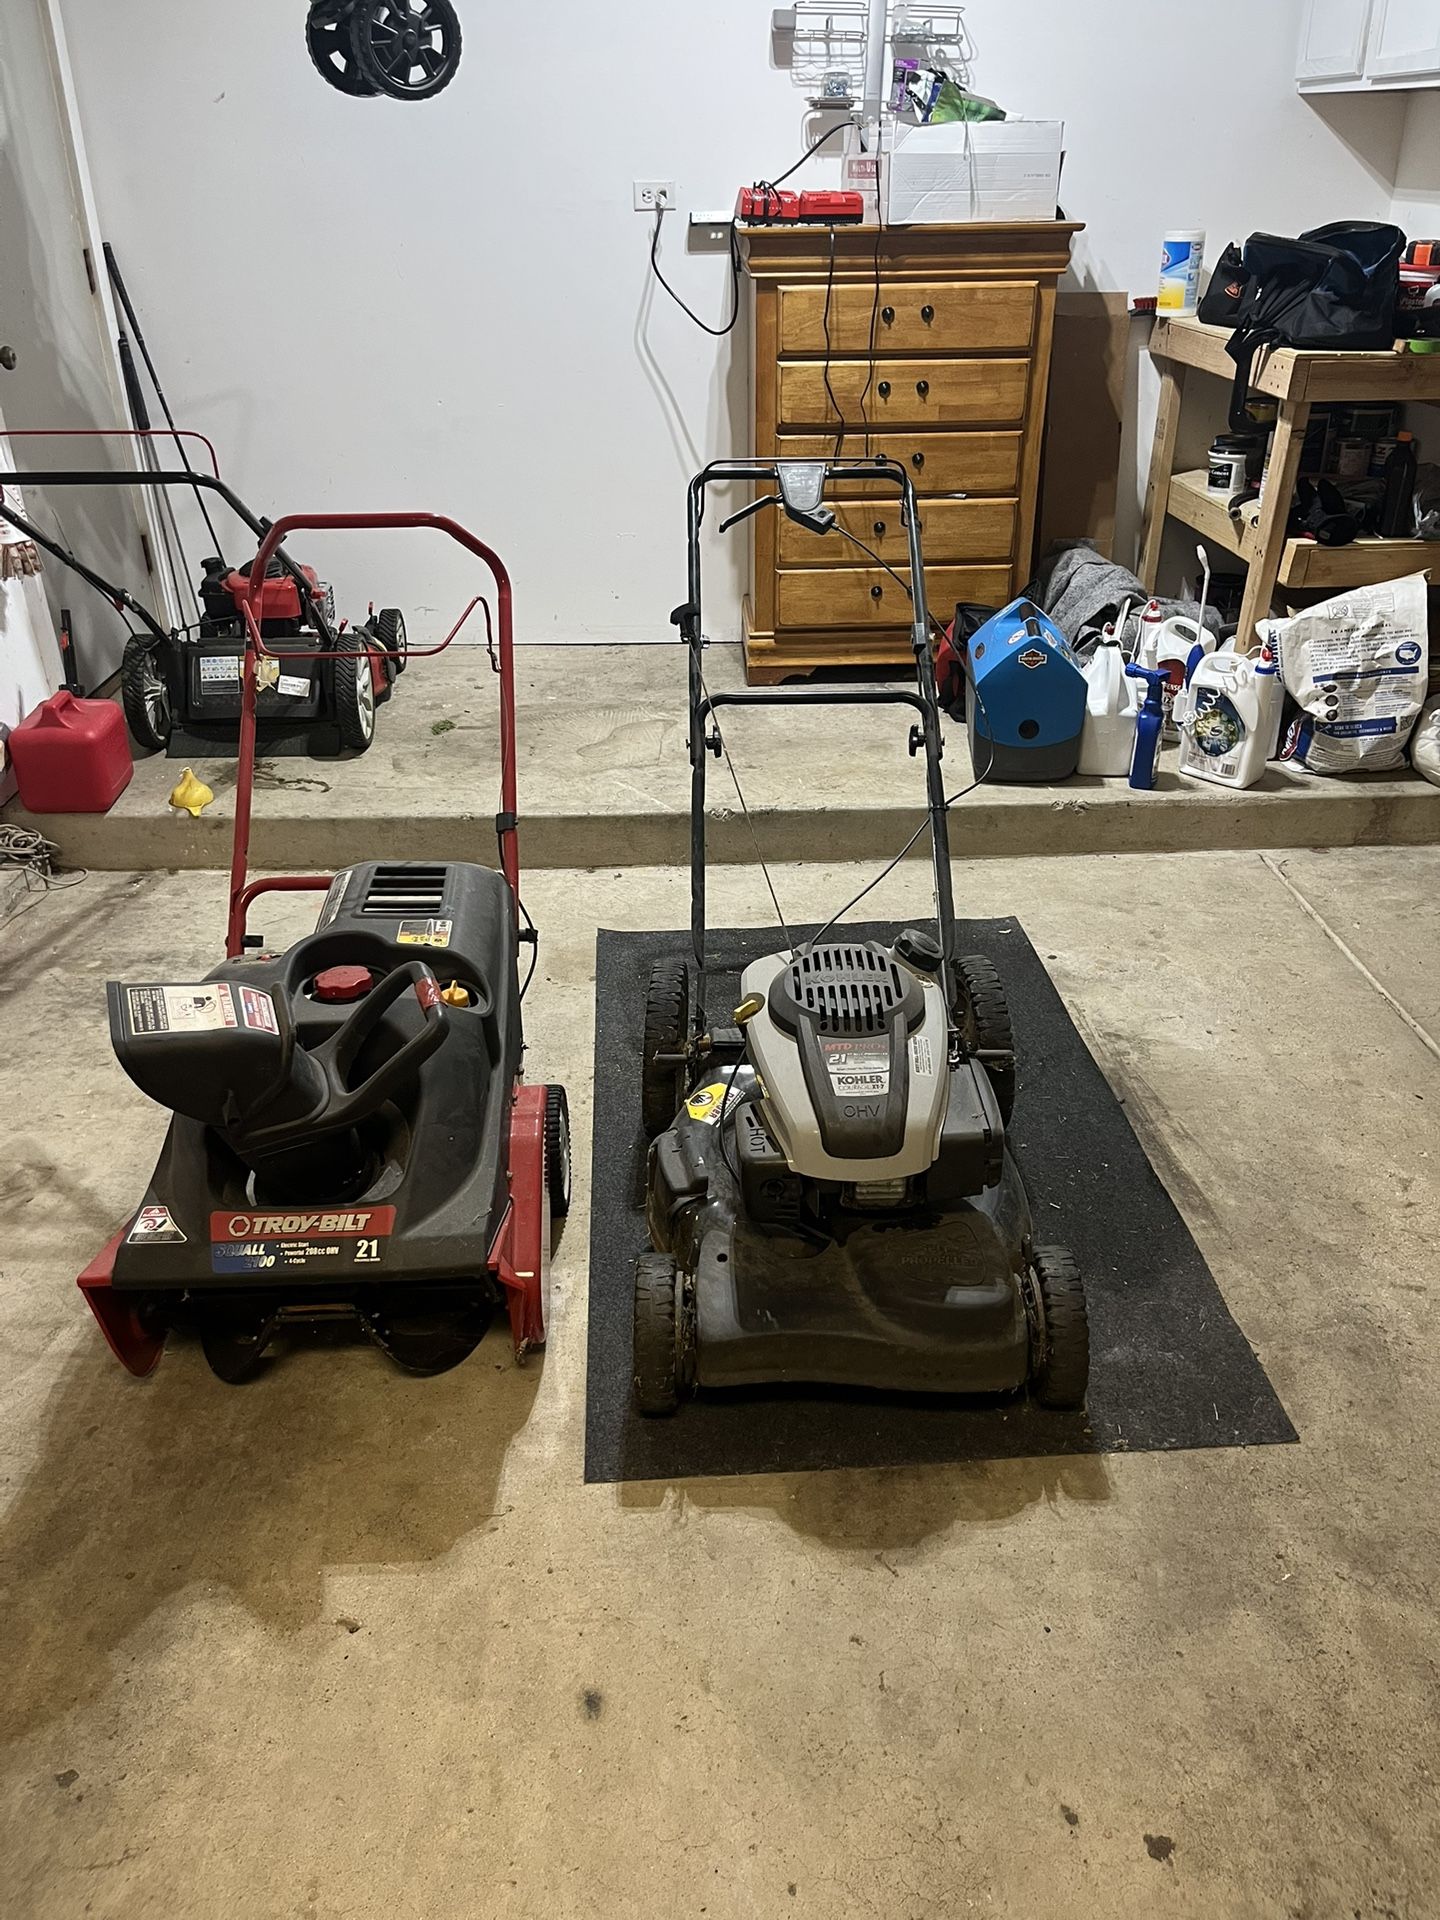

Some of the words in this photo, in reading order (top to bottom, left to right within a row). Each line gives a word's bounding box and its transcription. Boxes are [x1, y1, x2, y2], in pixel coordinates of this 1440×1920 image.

[829, 1053, 847, 1065] 21
[837, 1075, 883, 1085] KOHLER
[844, 1104, 880, 1118] OHV
[749, 1127, 766, 1153] HOT
[252, 1213, 372, 1235] TROY-BILT
[215, 1243, 266, 1258] SQUALL
[356, 1239, 379, 1258] 21
